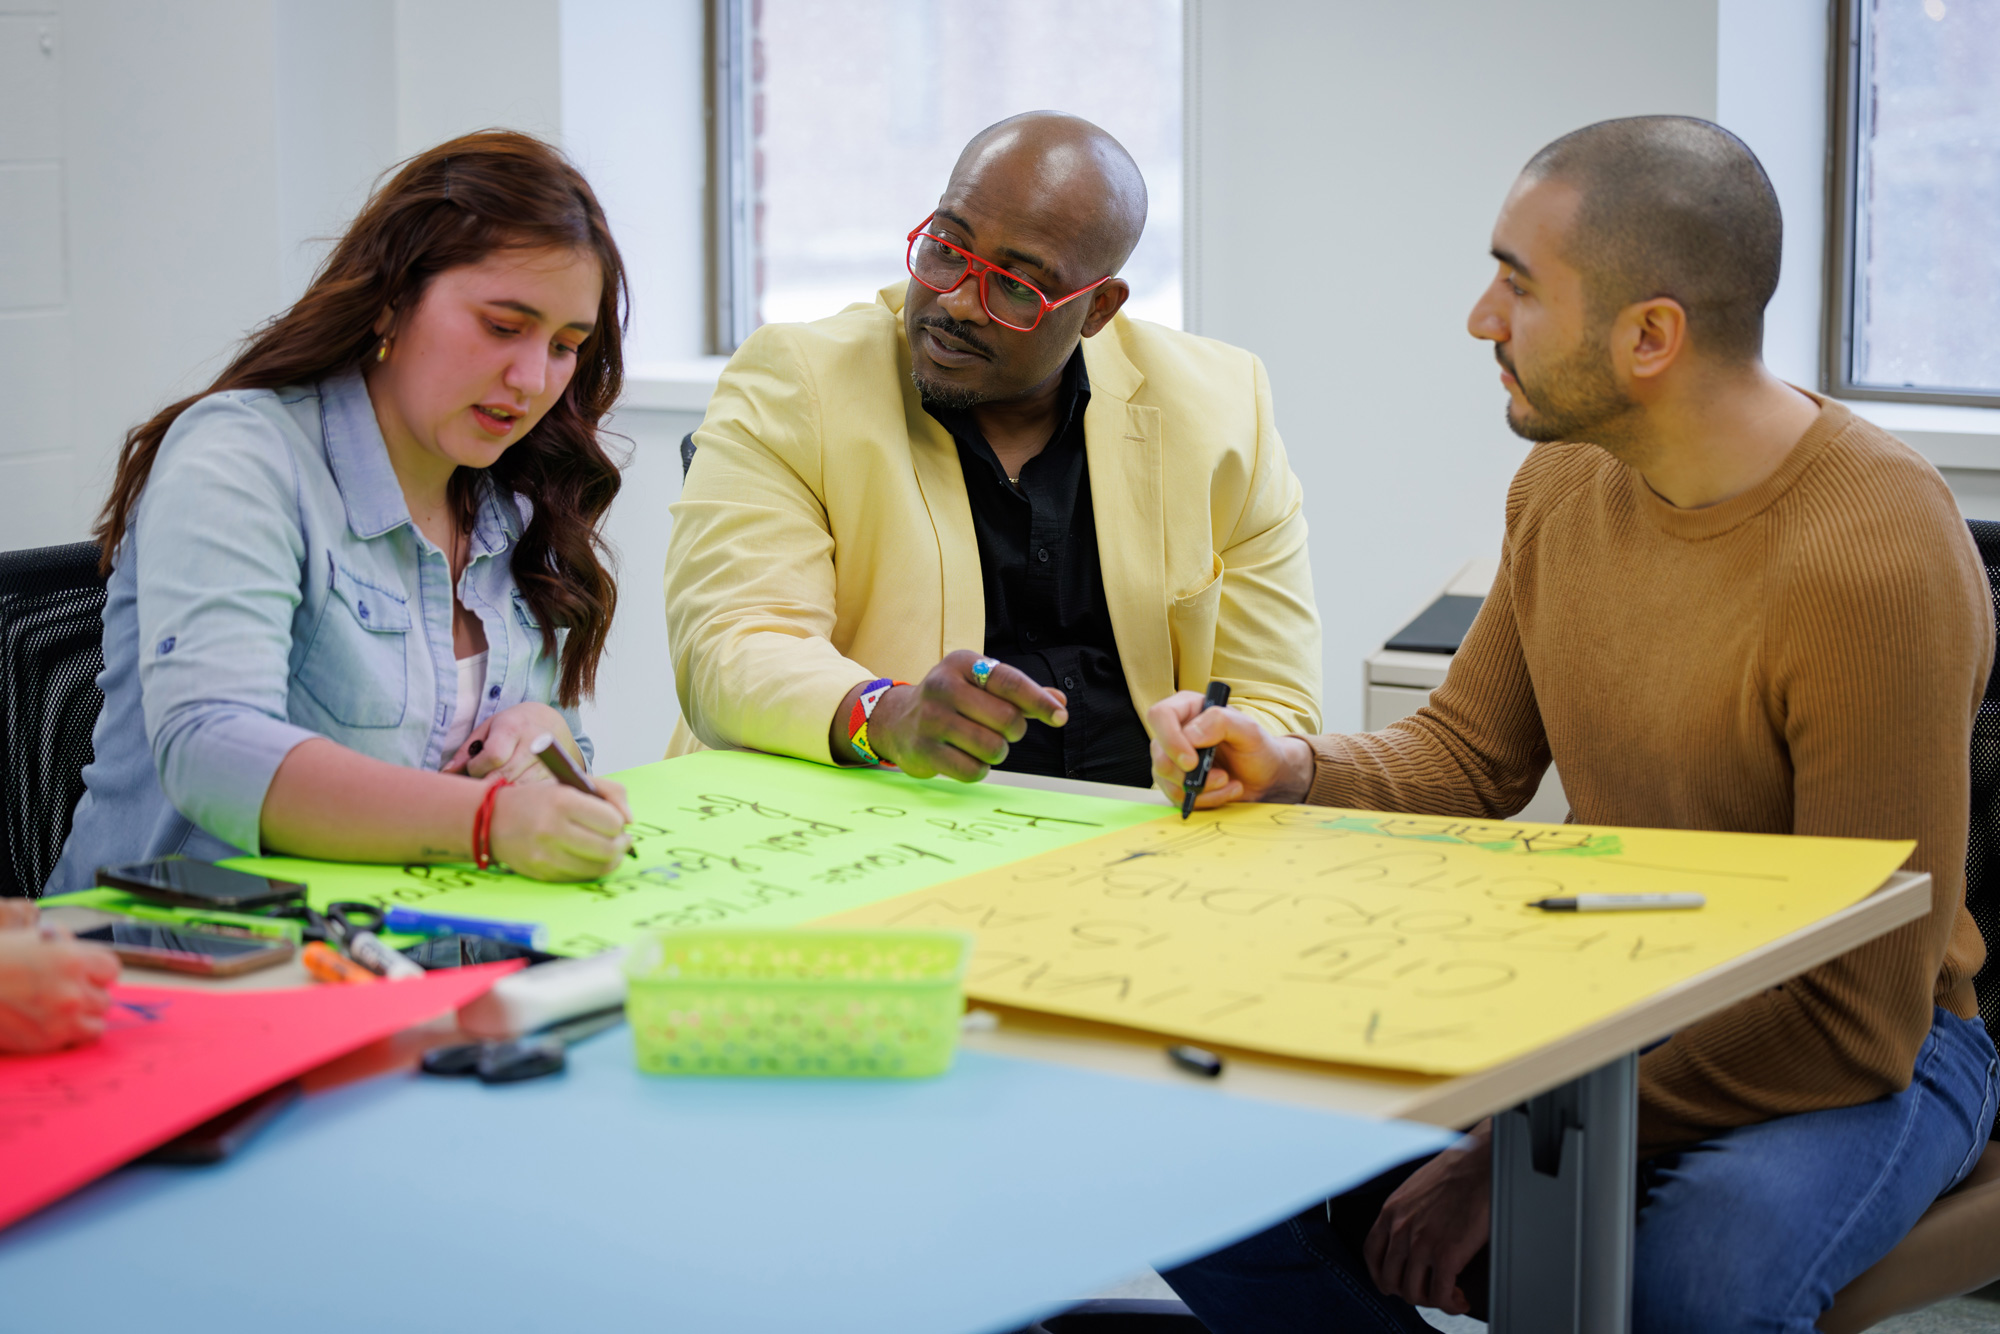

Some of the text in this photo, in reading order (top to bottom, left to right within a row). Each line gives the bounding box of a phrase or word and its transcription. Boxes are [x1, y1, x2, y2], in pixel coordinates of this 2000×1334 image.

[677, 794, 791, 821] for
[851, 805, 907, 819] a
[742, 816, 853, 857] push
[924, 808, 1104, 847] High
[809, 843, 955, 884] house
[633, 877, 802, 928] prices
[884, 898, 1052, 927] AN
[1010, 862, 1698, 962] AFFORDABLE
[1070, 920, 1170, 950] IS
[1345, 1010, 1475, 1045] A
